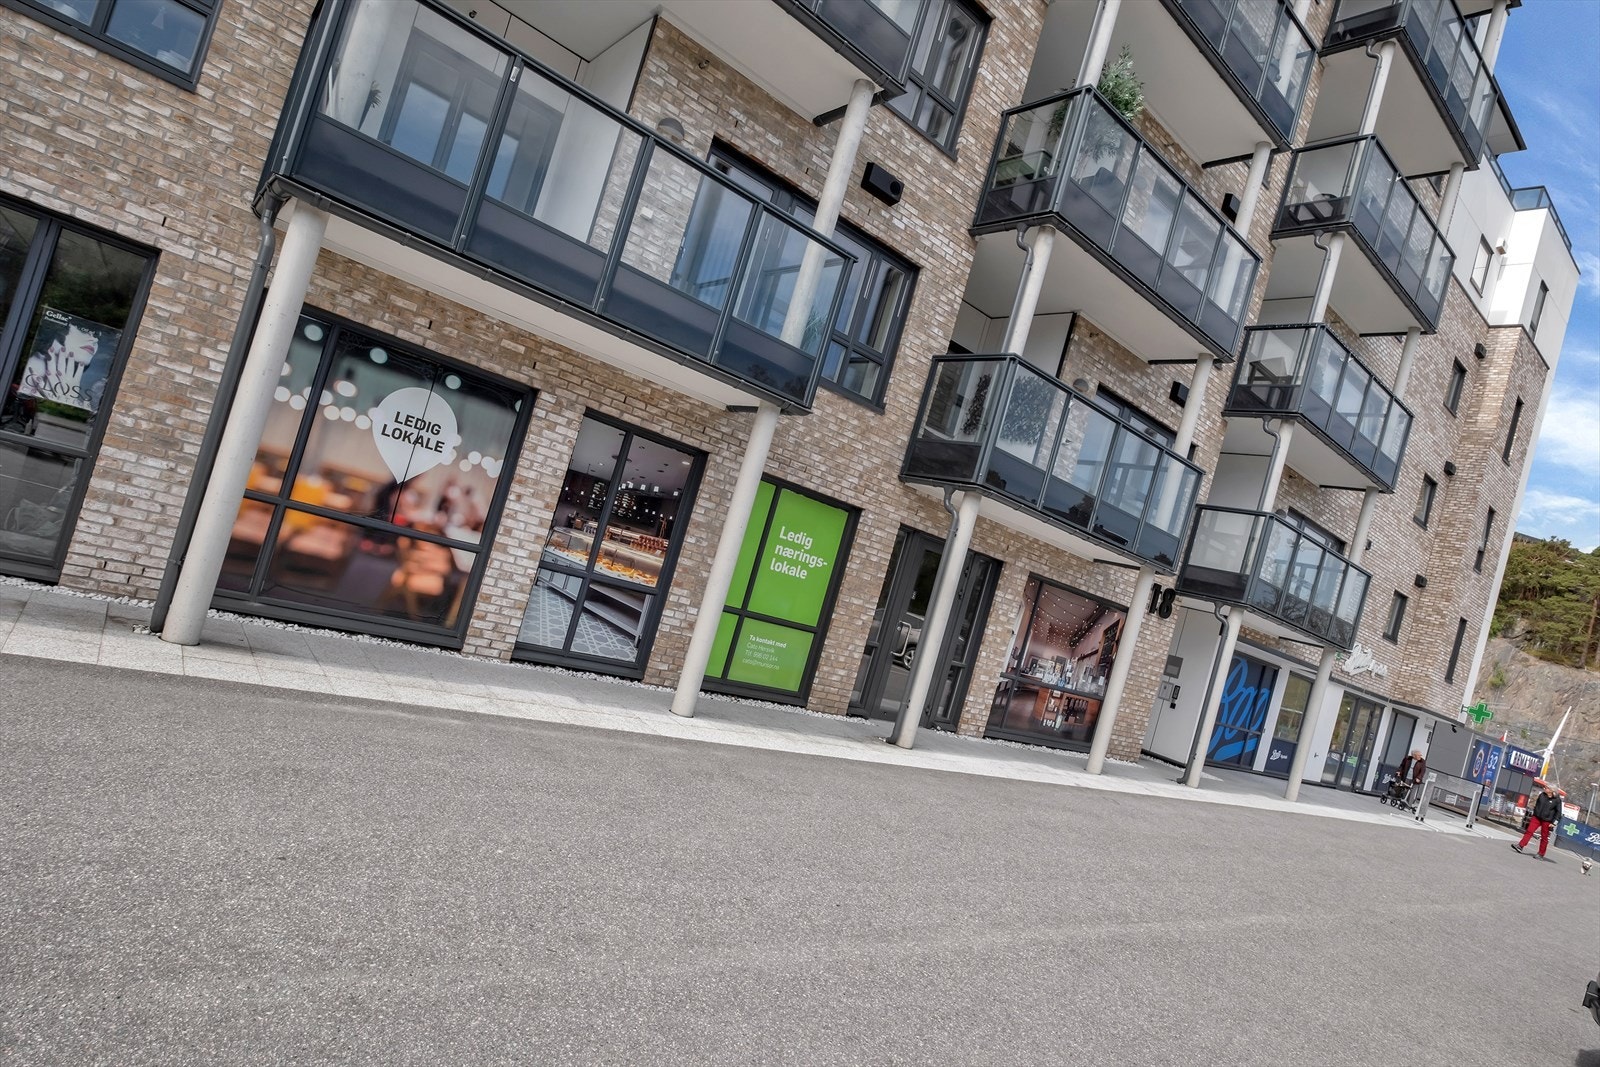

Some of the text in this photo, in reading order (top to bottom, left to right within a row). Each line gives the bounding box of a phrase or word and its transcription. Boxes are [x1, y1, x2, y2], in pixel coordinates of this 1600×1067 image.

[394, 411, 442, 436] LEDIG
[381, 424, 445, 453] LOKALE
[779, 526, 813, 549] Ledig
[770, 557, 808, 579] lokale
[775, 544, 828, 568] nærings-
[1148, 582, 1176, 619] 18
